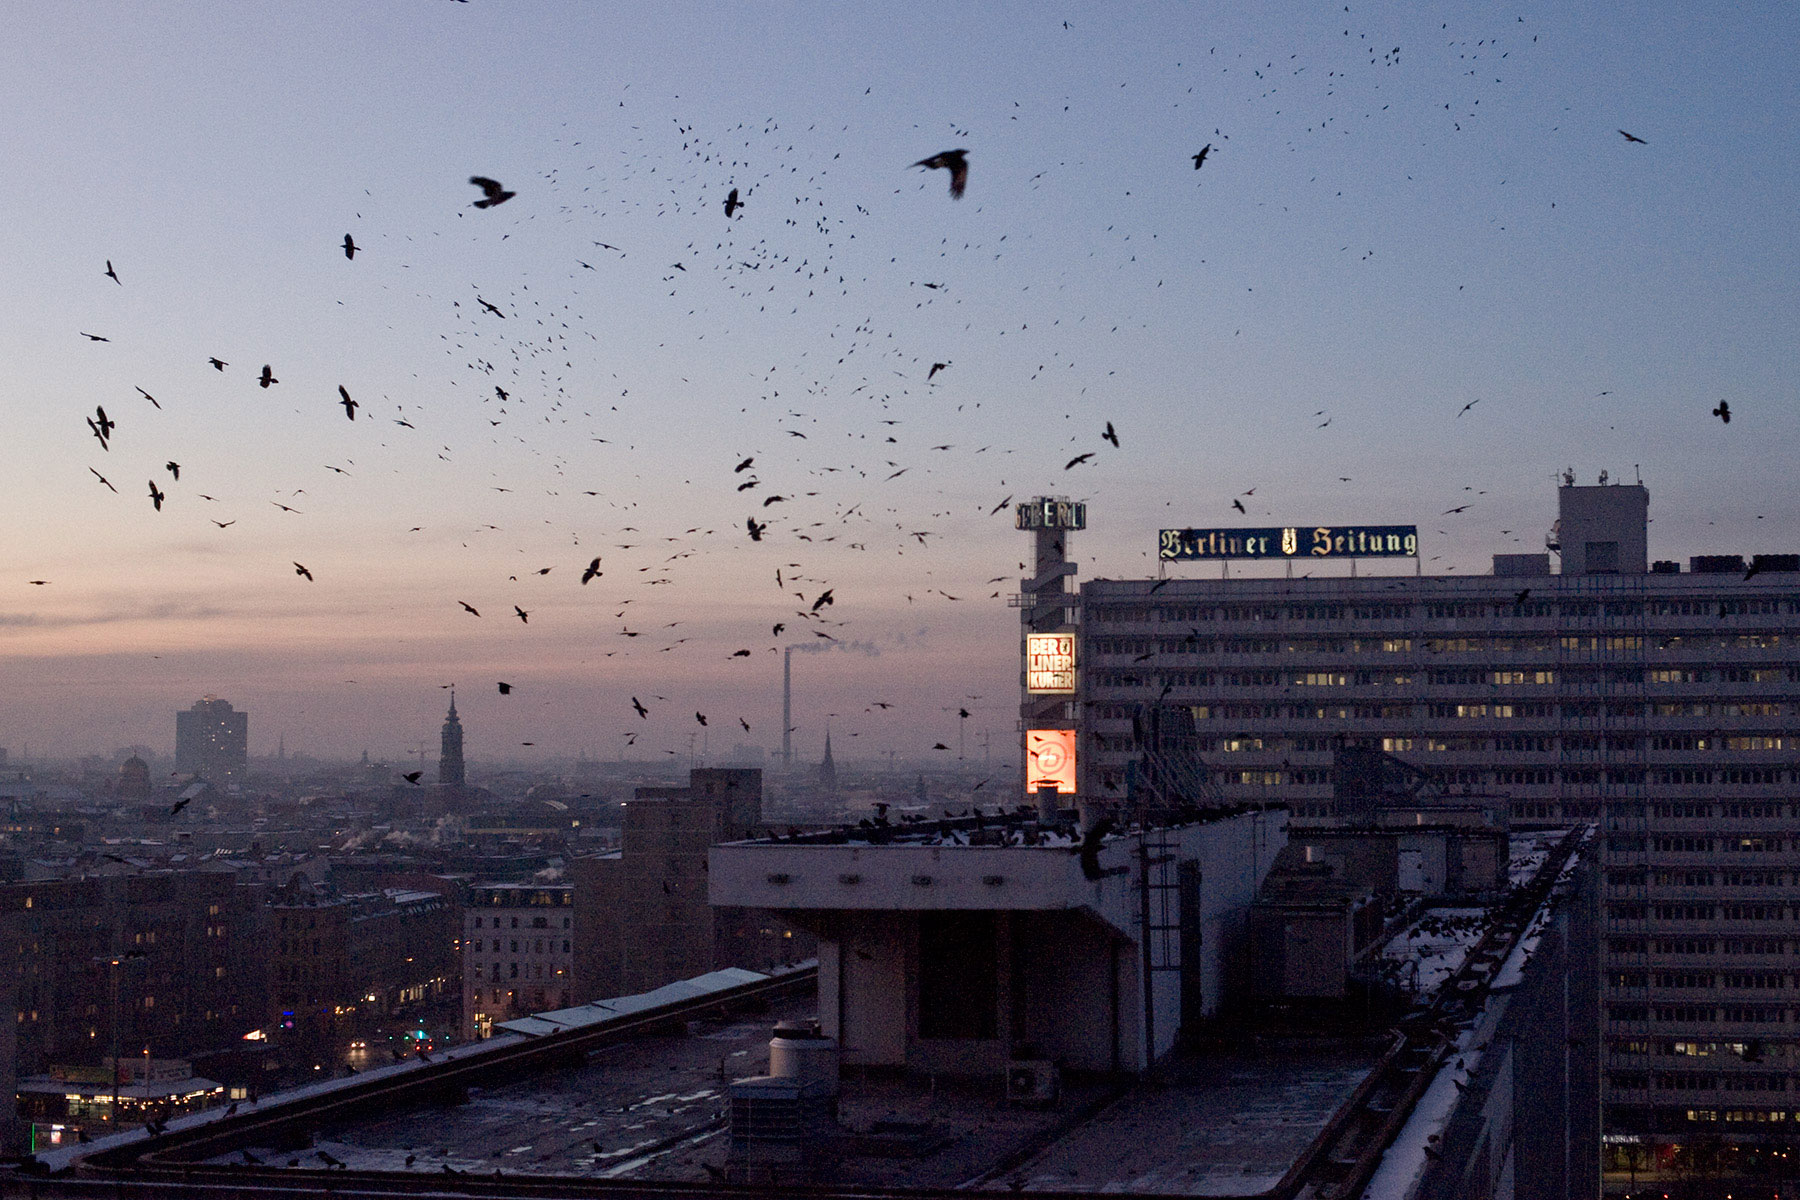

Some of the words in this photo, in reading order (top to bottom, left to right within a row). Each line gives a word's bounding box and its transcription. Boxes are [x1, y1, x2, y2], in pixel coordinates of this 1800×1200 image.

[1311, 527, 1416, 556] Zeitung
[1030, 638, 1059, 655] BER
[1030, 655, 1072, 671] LINER
[1030, 671, 1072, 688] KURIER
